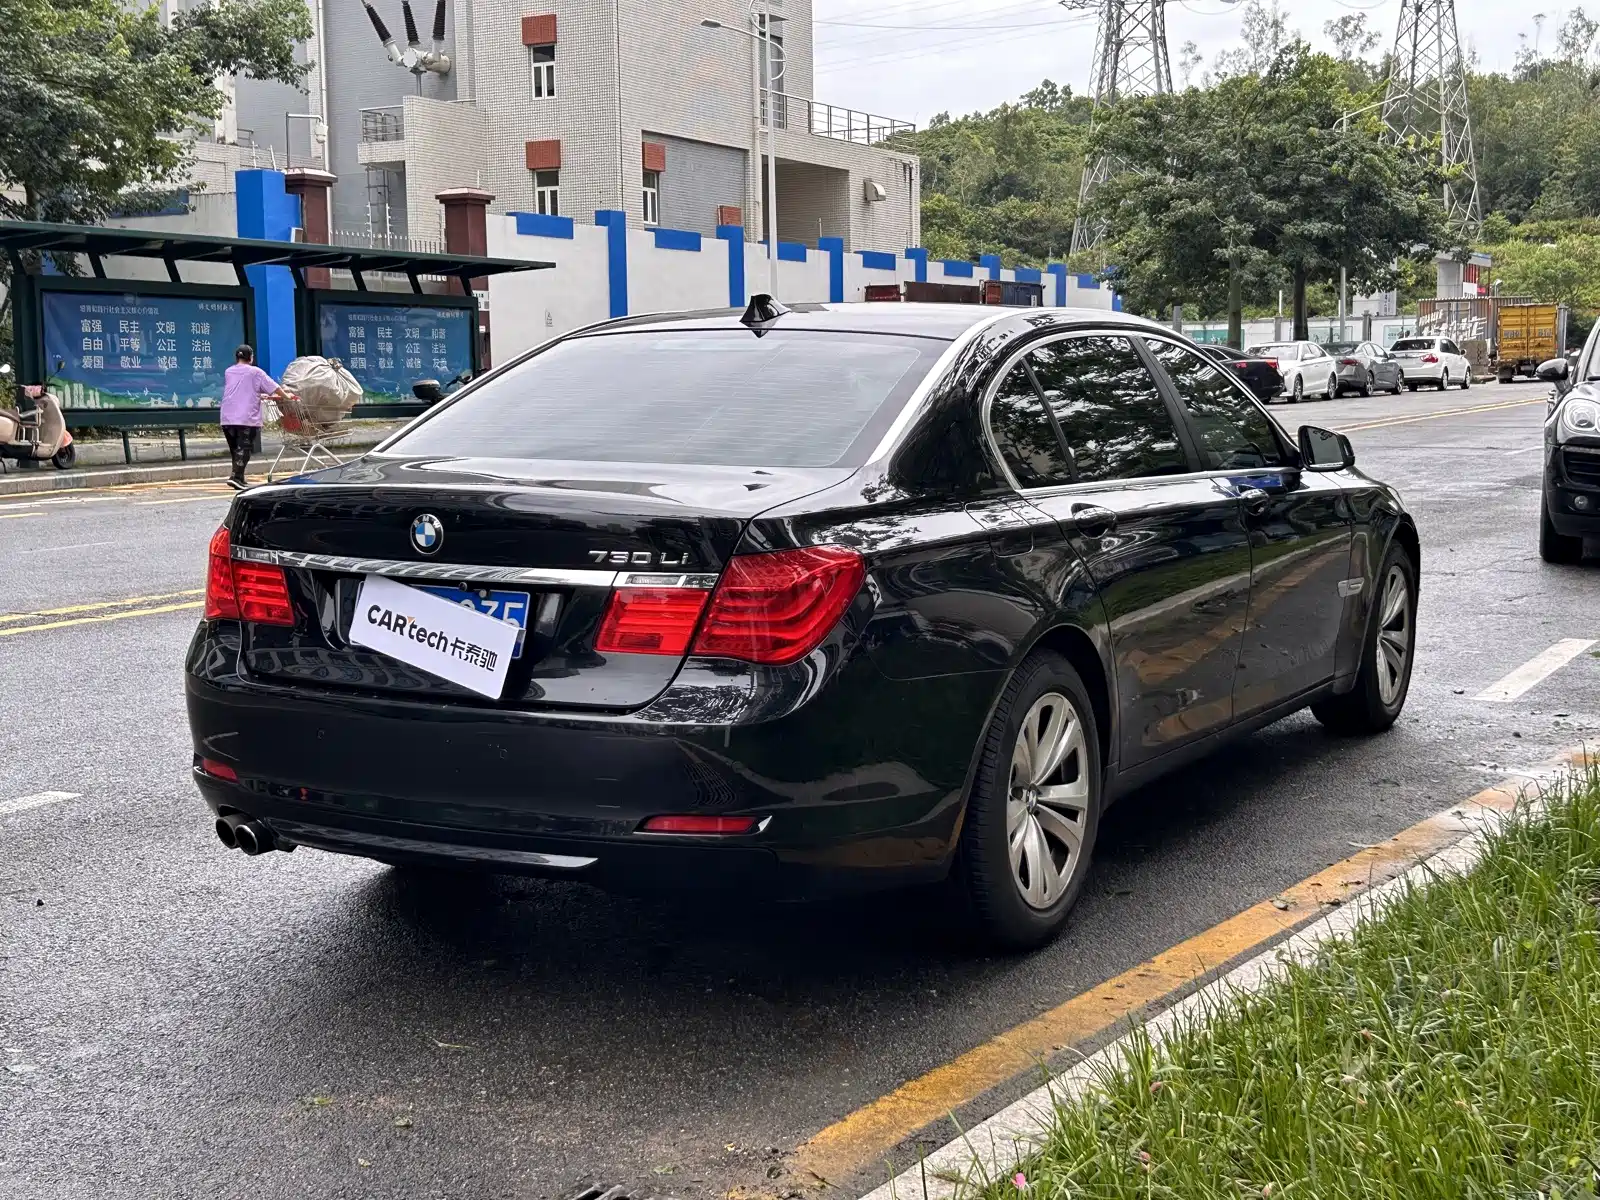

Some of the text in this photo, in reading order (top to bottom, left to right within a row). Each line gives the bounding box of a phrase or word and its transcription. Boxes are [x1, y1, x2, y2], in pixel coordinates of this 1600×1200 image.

[80, 318, 211, 336] 富强 民主 文明 和谐
[348, 326, 366, 339] 富强
[377, 326, 393, 339] 民主
[404, 327, 420, 339] 文明
[82, 337, 212, 353] 自由 平等 公正 法治
[349, 341, 447, 354] 自由 平等 公正 法治
[81, 355, 213, 370] 爱国 敬业 诚信 友善
[350, 357, 367, 369] 爱国
[588, 550, 689, 565] 730 Li
[367, 604, 449, 653] CARtech
[449, 636, 498, 673] 卡泰驰
